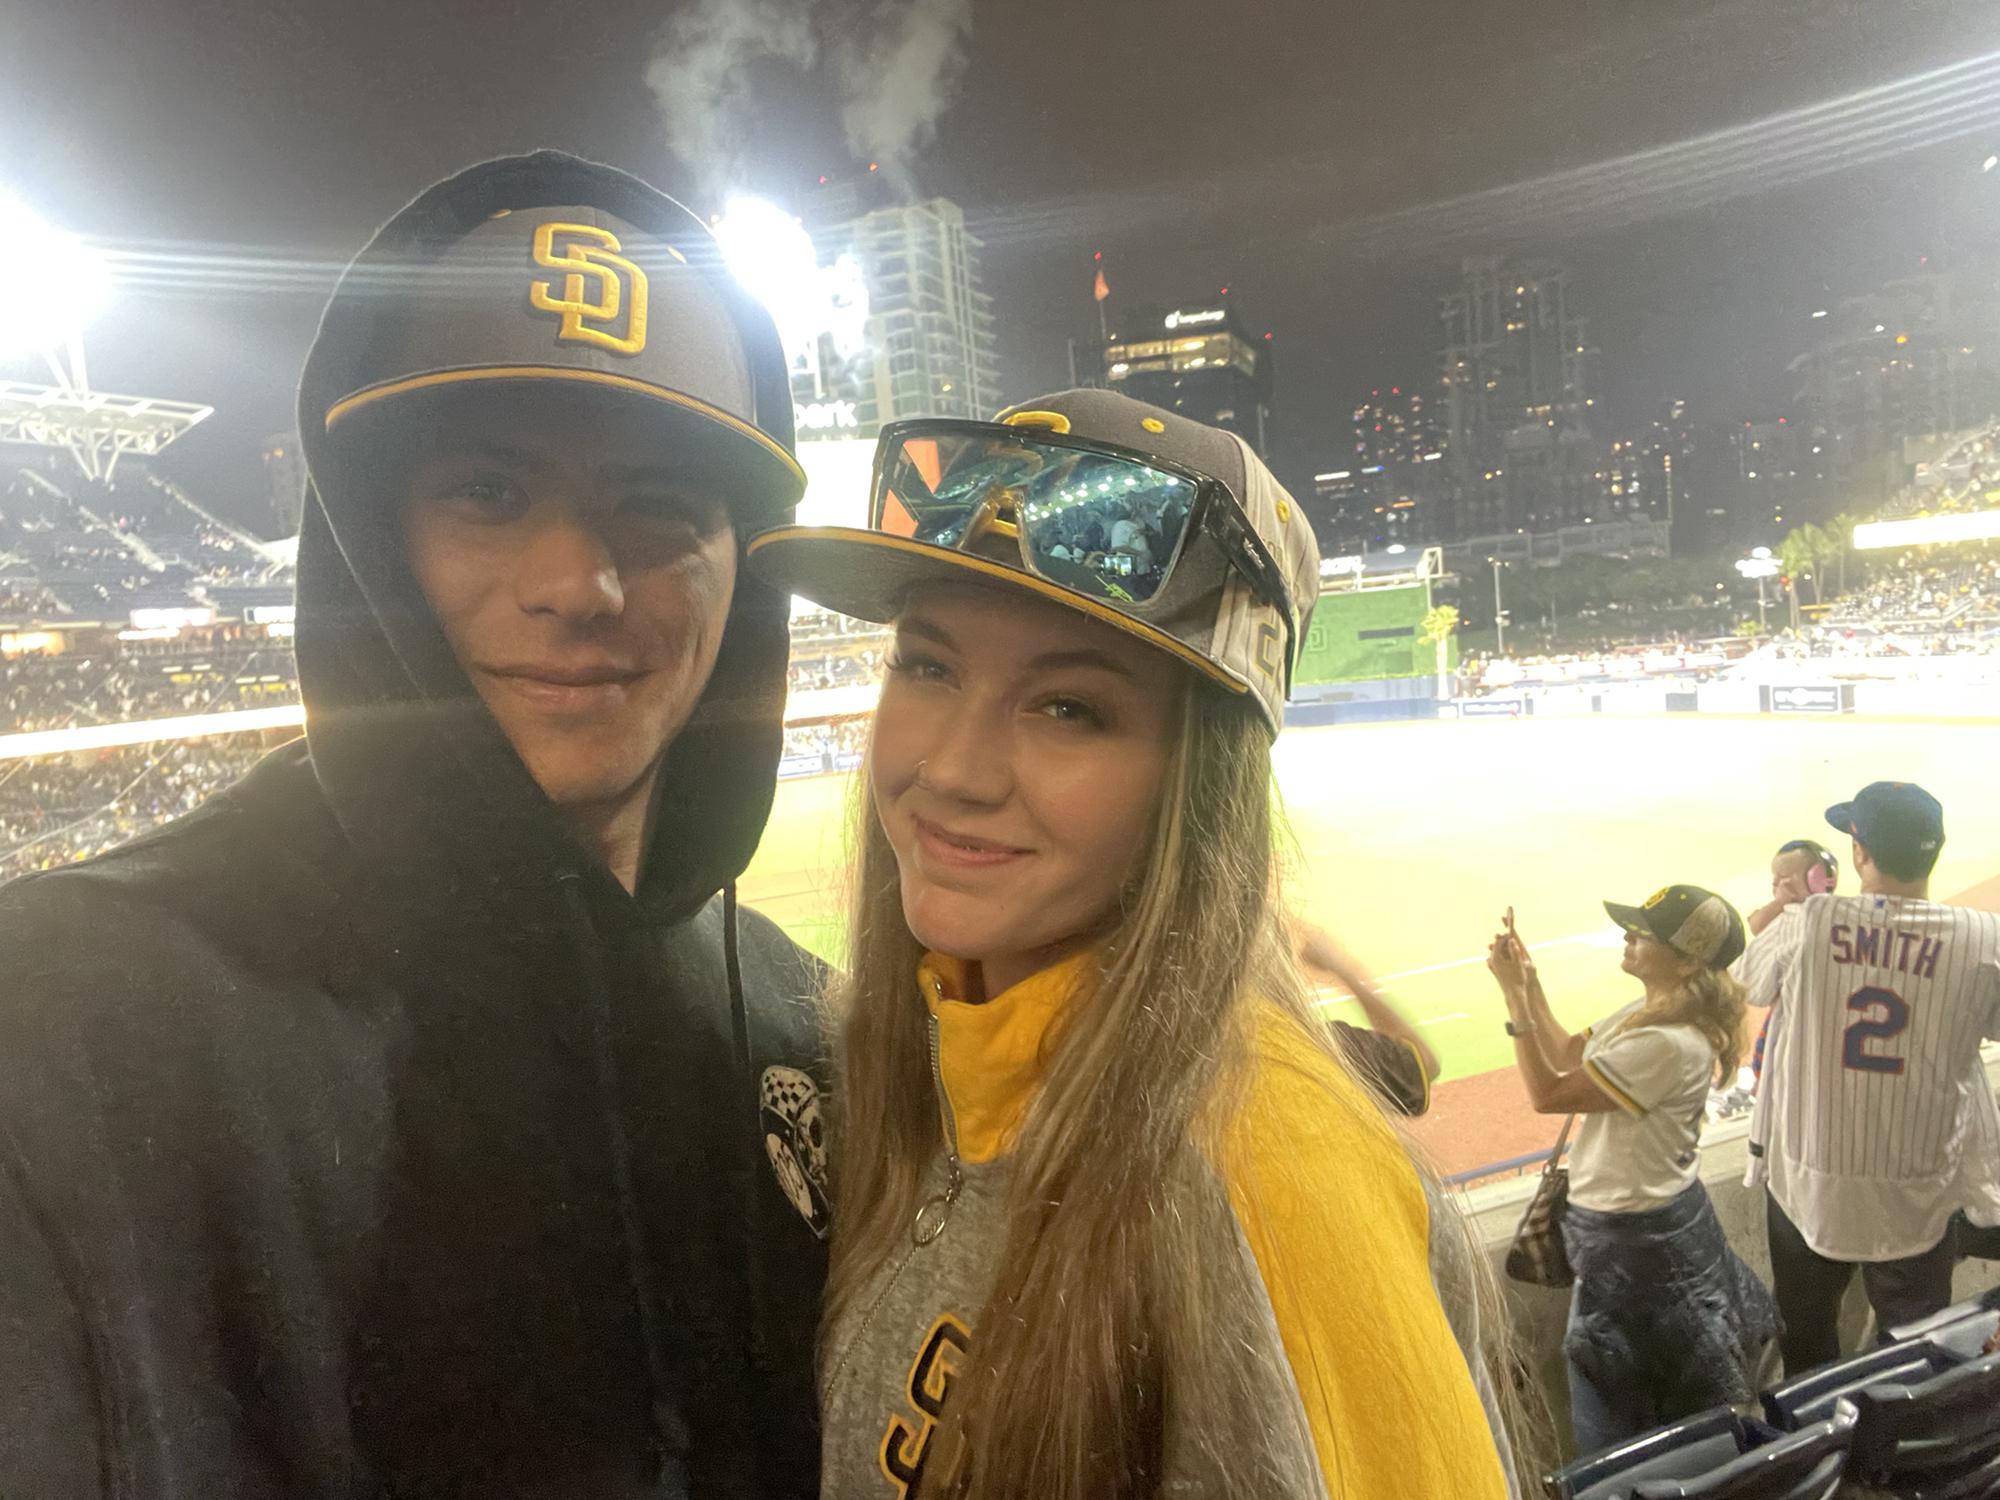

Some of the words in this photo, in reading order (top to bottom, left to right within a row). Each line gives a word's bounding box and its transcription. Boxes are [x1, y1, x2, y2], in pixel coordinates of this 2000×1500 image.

[530, 222, 648, 355] SD
[1831, 924, 1943, 979] SMITH
[1841, 985, 1910, 1075] 2
